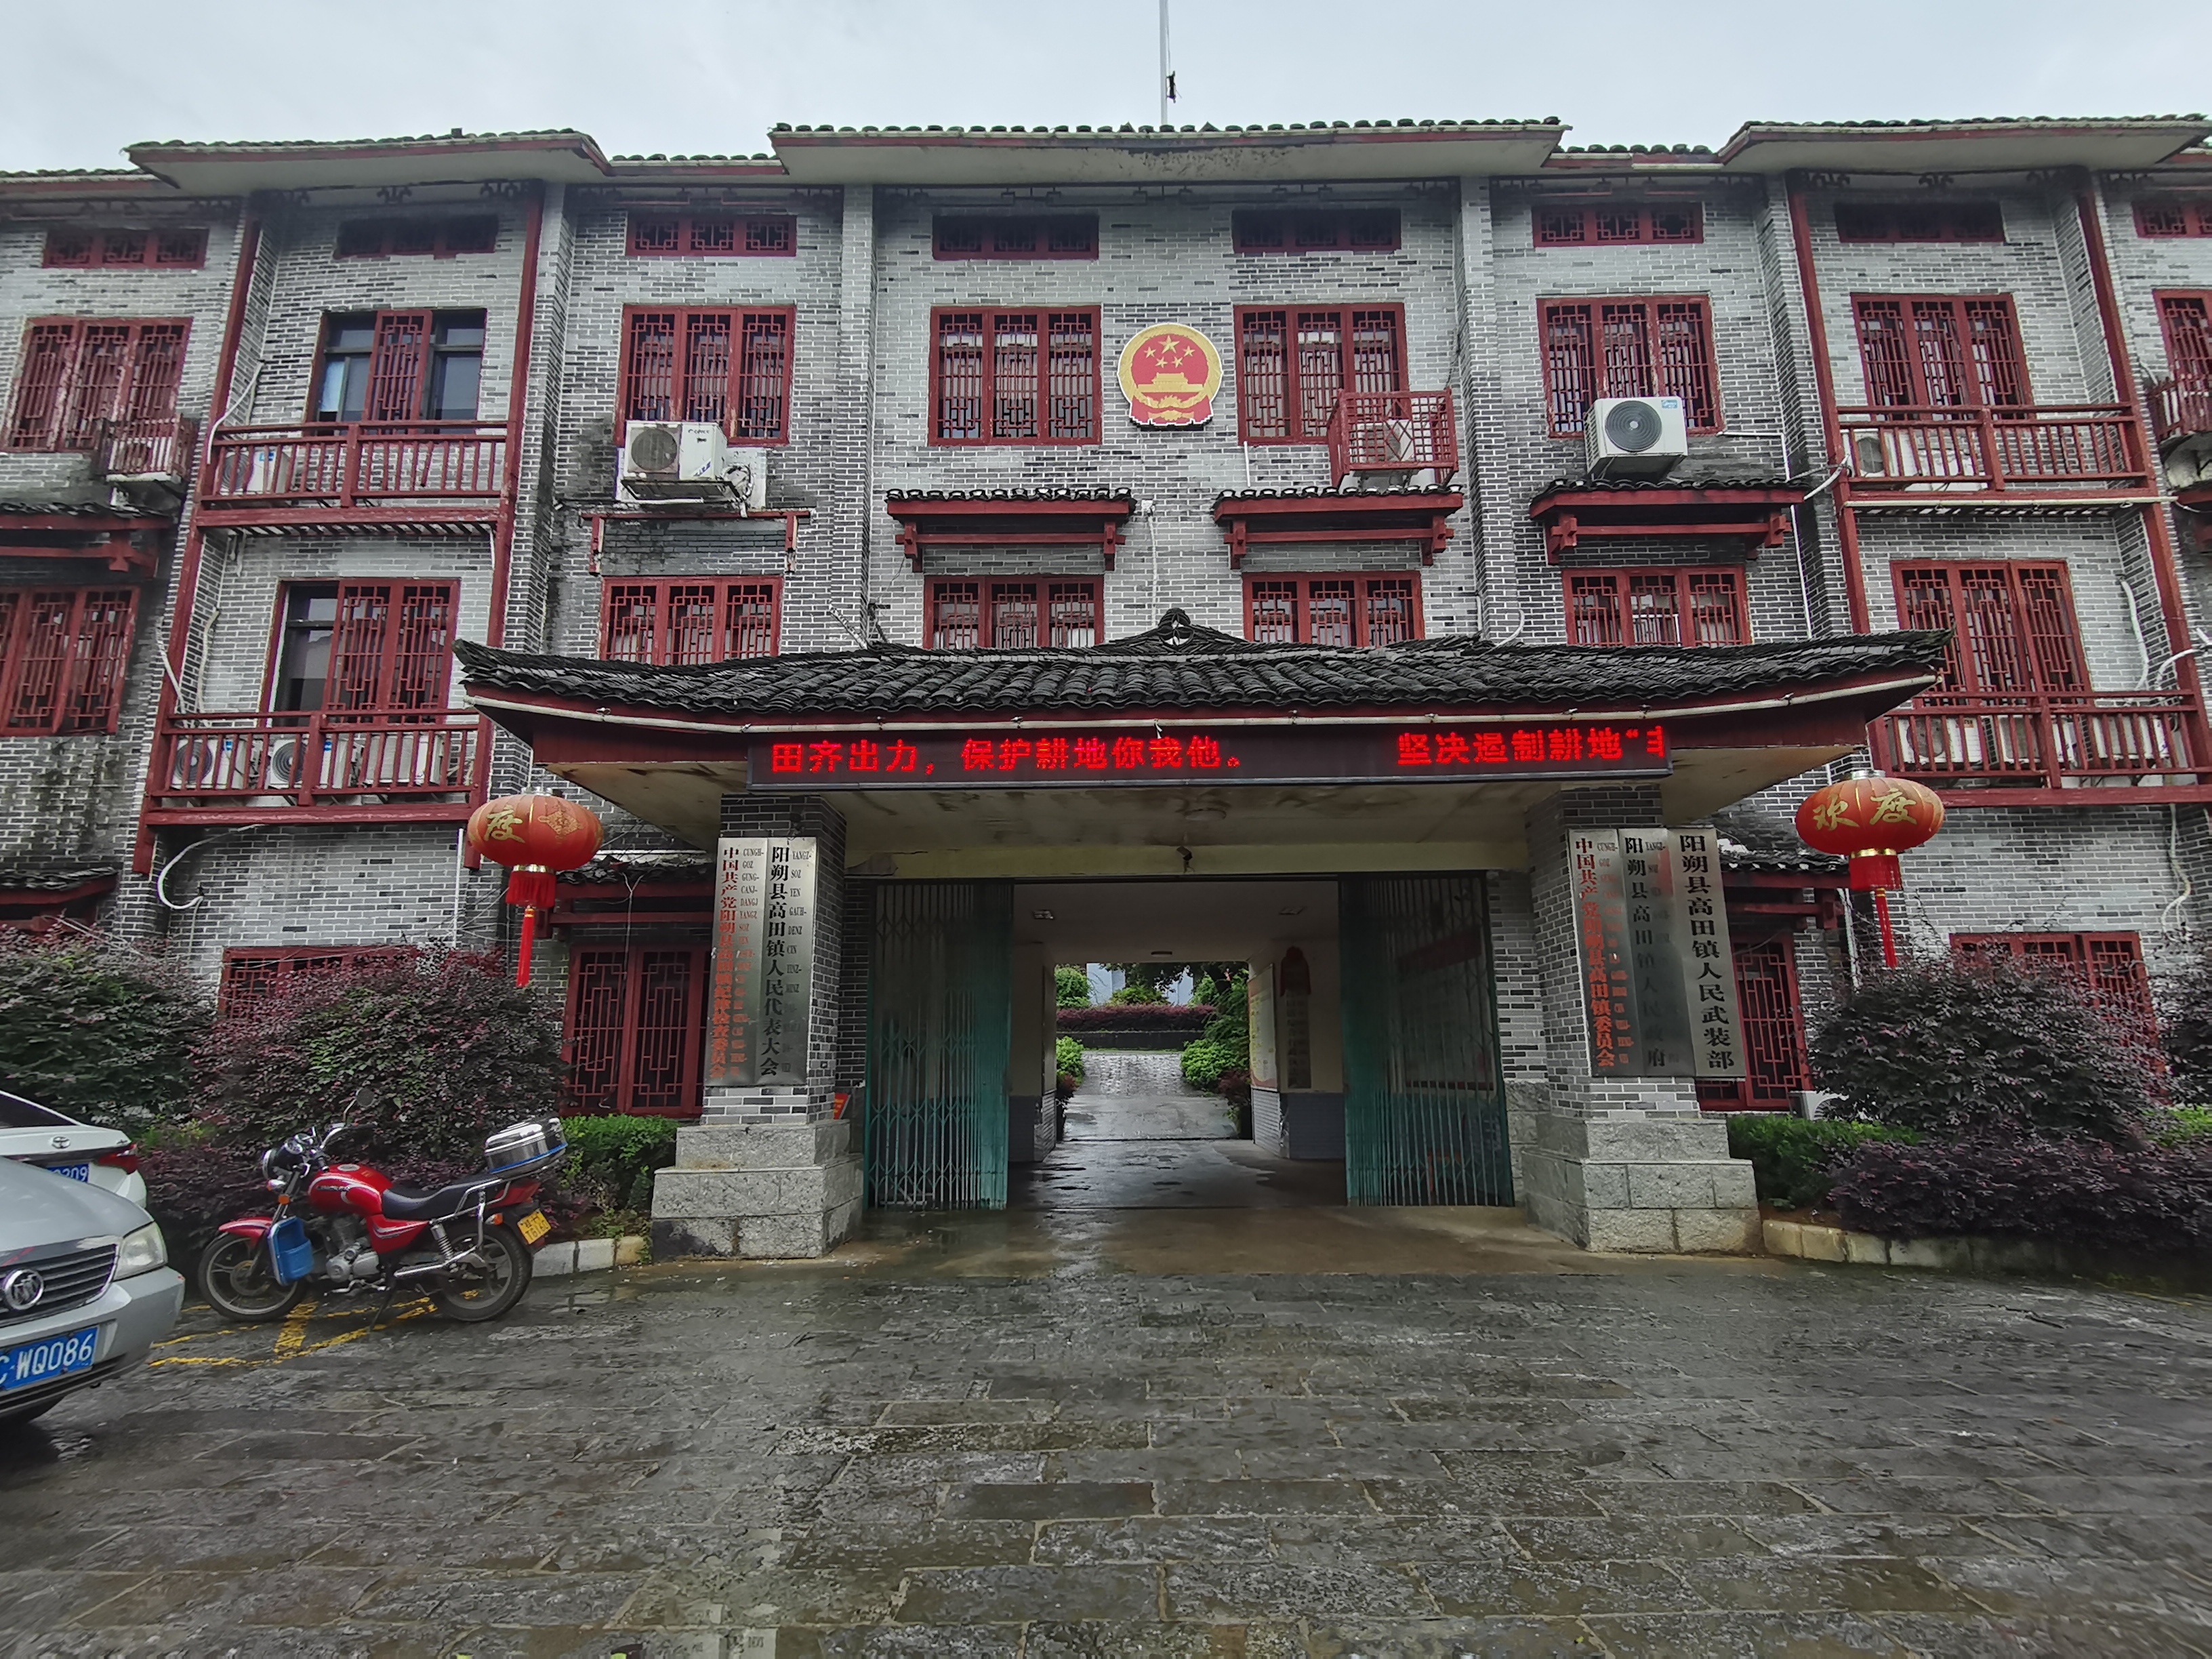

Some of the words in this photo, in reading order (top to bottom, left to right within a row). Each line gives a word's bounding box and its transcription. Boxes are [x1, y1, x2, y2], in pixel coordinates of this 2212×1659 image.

[484, 804, 526, 844] 度
[1812, 787, 1918, 832] 欢度
[760, 846, 790, 1076] 阳朔县高田镇人民代表大会
[1576, 838, 1615, 1067] 中国共产党阳朔县高田镇委员会
[1624, 837, 1666, 1067] 阳朔县高田镇人民政府
[1679, 835, 1735, 1069] 阳朔县高田镇人民武装部
